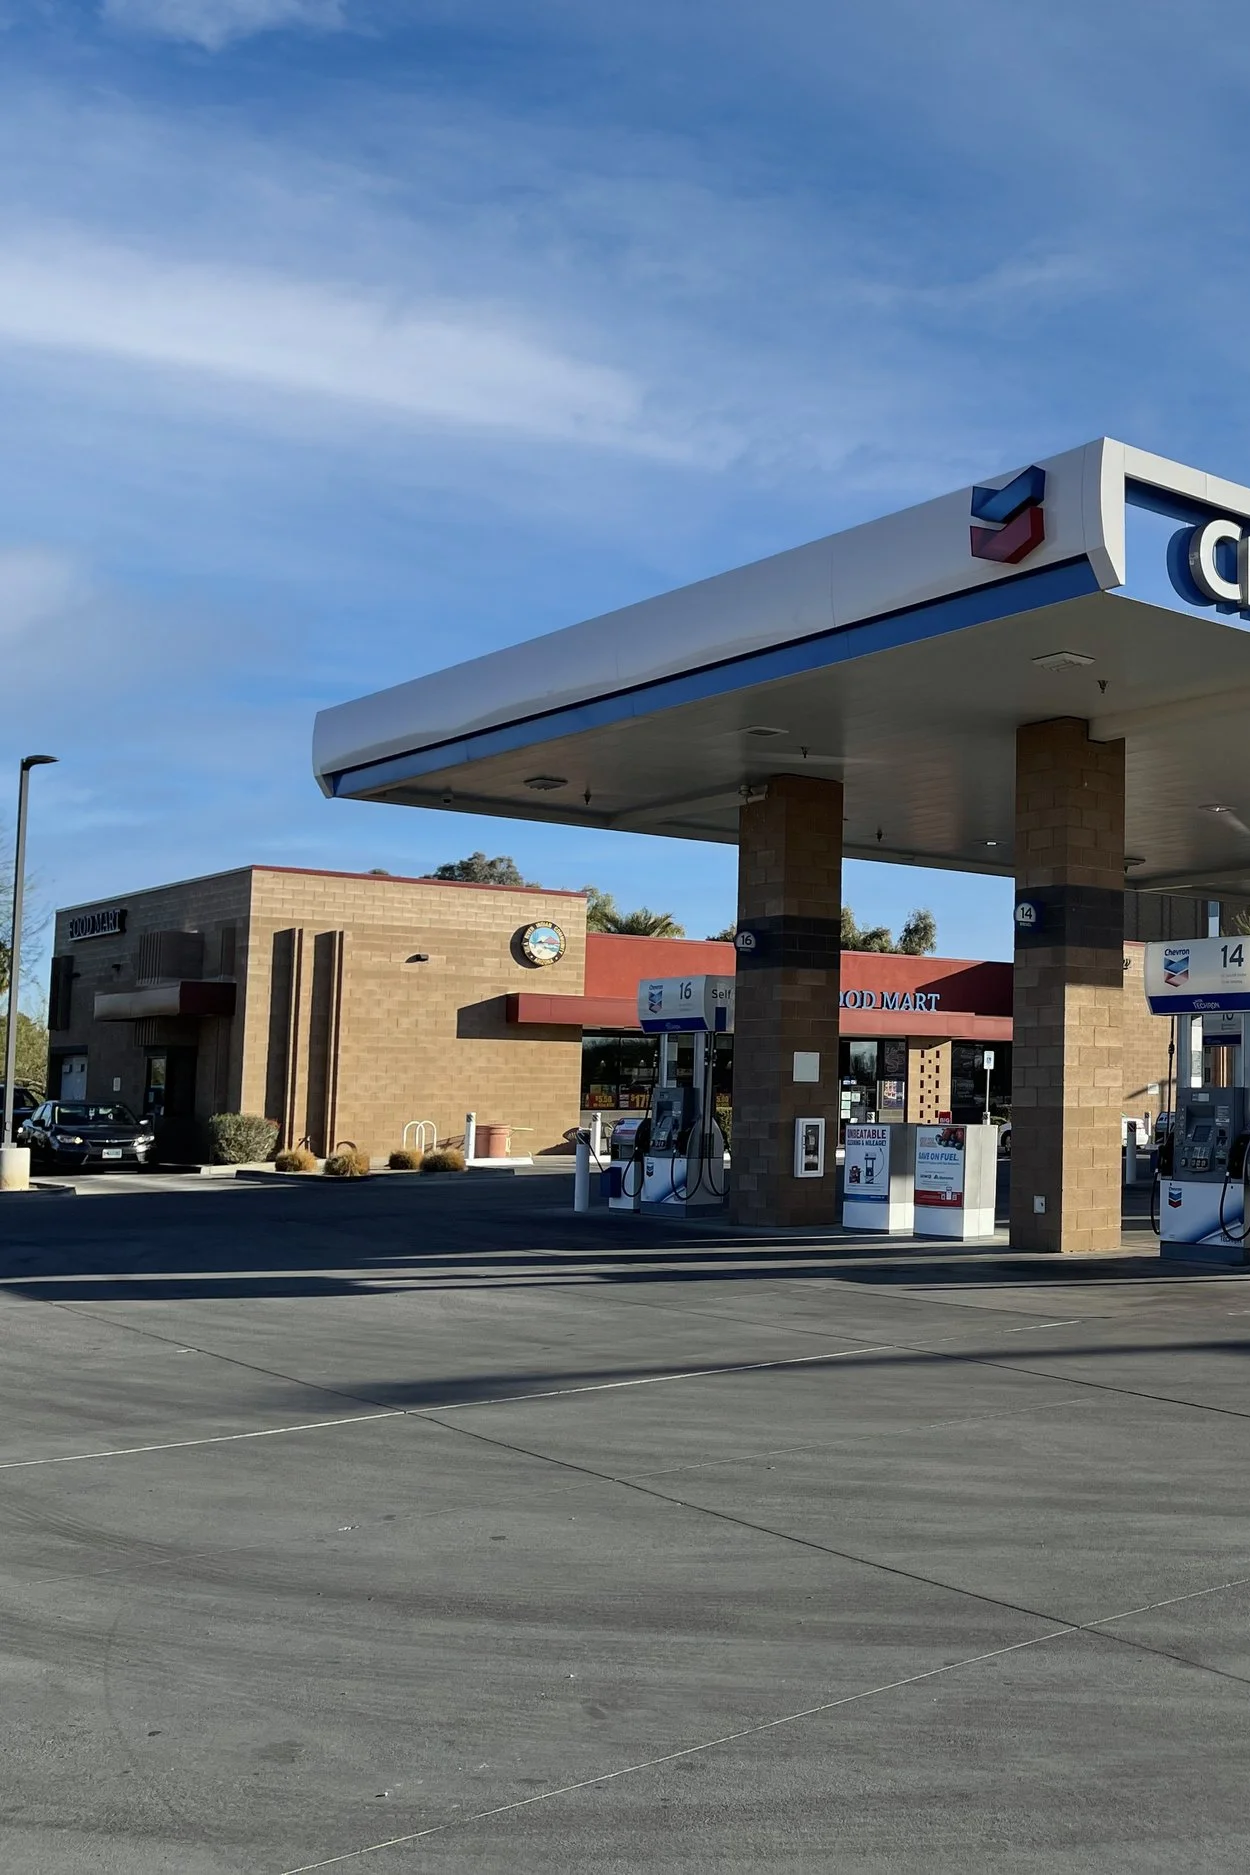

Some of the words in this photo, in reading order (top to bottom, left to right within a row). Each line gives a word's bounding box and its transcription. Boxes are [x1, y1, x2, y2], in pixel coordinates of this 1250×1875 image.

[1021, 906, 1033, 919] 14
[69, 914, 94, 939] FOOD
[94, 909, 121, 933] MART
[741, 934, 752, 946] 16
[1164, 948, 1190, 957] Chevron
[1221, 944, 1244, 968] 14
[679, 982, 692, 1000] 16
[711, 989, 731, 999] Self
[881, 991, 940, 1012] MART
[1192, 1001, 1220, 1010] TECHRON
[847, 1128, 887, 1140] UNBEATABLE
[918, 1151, 930, 1160] SAVE
[930, 1152, 940, 1161] ON
